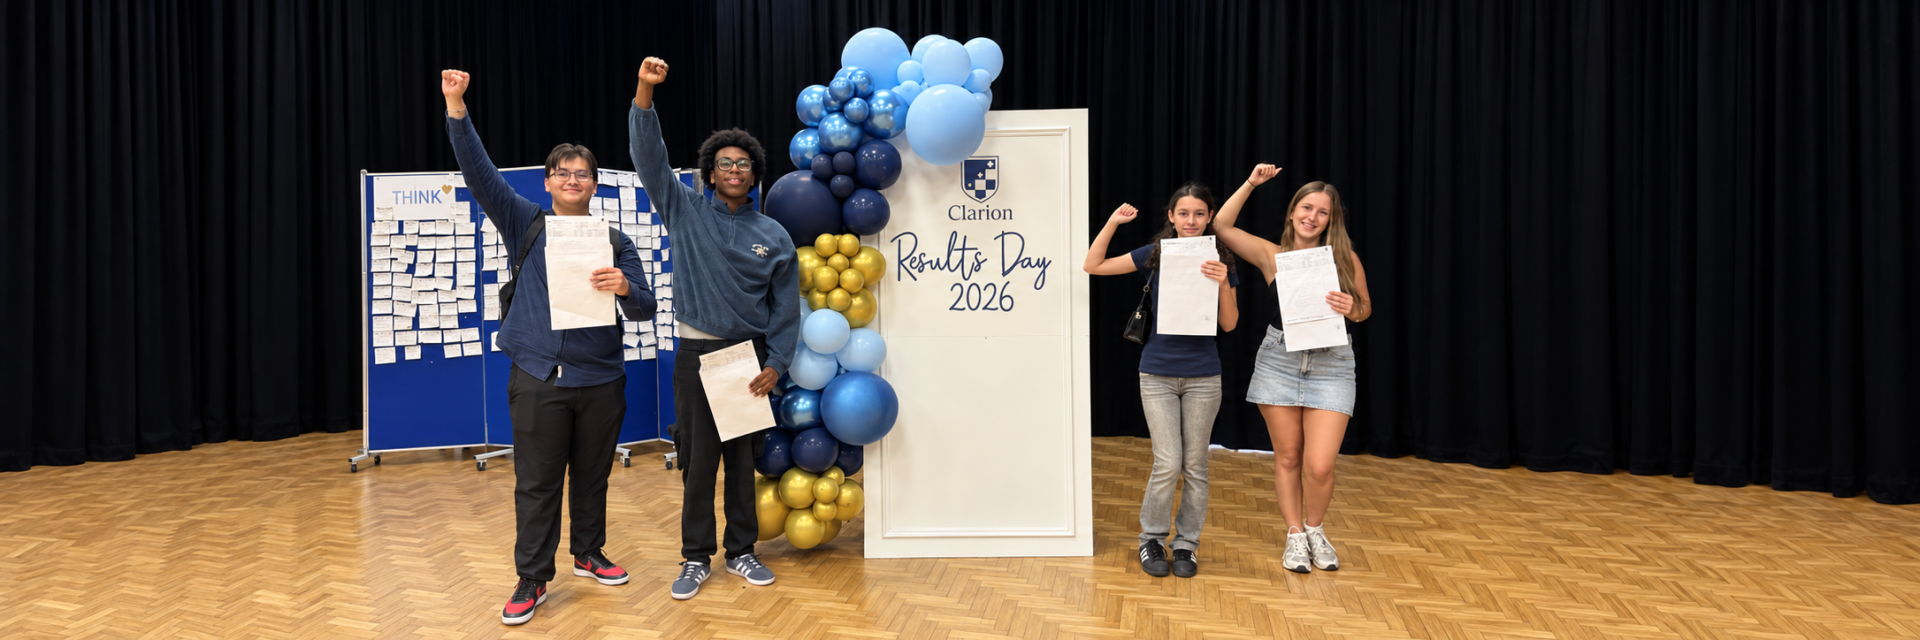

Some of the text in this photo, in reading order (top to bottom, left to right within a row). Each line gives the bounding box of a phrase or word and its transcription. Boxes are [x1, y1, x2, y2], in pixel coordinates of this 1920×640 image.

[392, 189, 442, 205] THINK
[948, 204, 1013, 221] Clarion
[890, 230, 1052, 290] Results Day
[949, 281, 1014, 312] 2026
